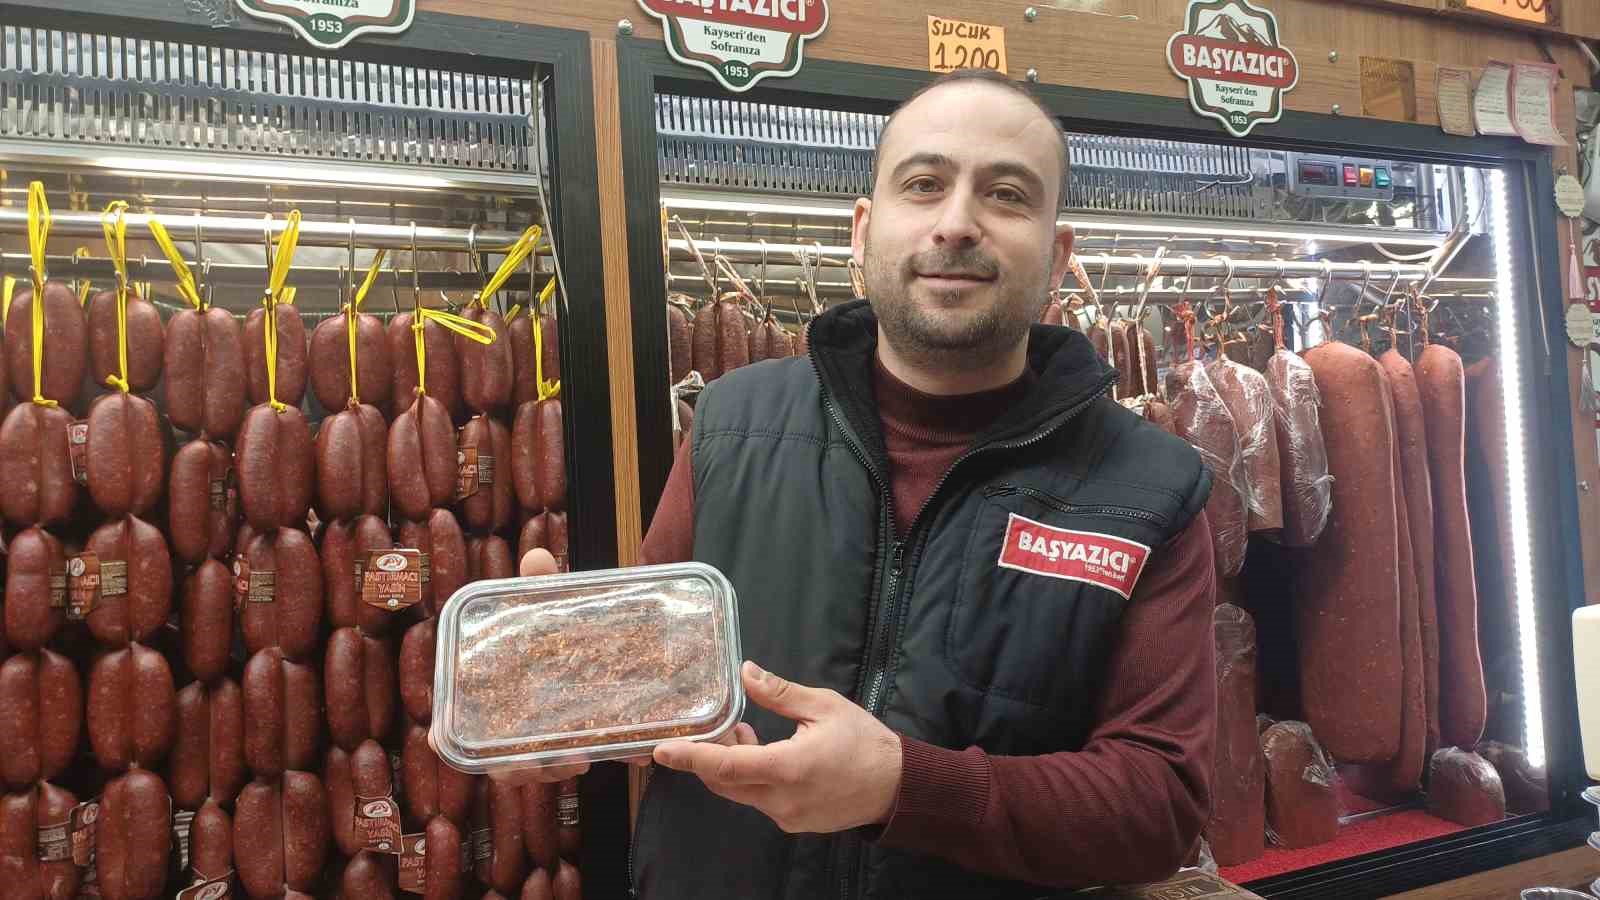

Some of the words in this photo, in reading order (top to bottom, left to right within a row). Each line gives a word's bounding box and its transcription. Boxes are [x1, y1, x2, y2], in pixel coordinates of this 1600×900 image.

[310, 19, 343, 34] 1953
[703, 25, 767, 43] Kayseri'den
[931, 20, 991, 40] SUCUK
[711, 40, 761, 56] Sofranıza
[934, 42, 1000, 70] 1.200
[1183, 43, 1284, 78] BAŞYAZICI
[723, 65, 749, 78] 1953
[1230, 115, 1248, 125] 1953
[1018, 530, 1131, 573] BAŞYAZICI
